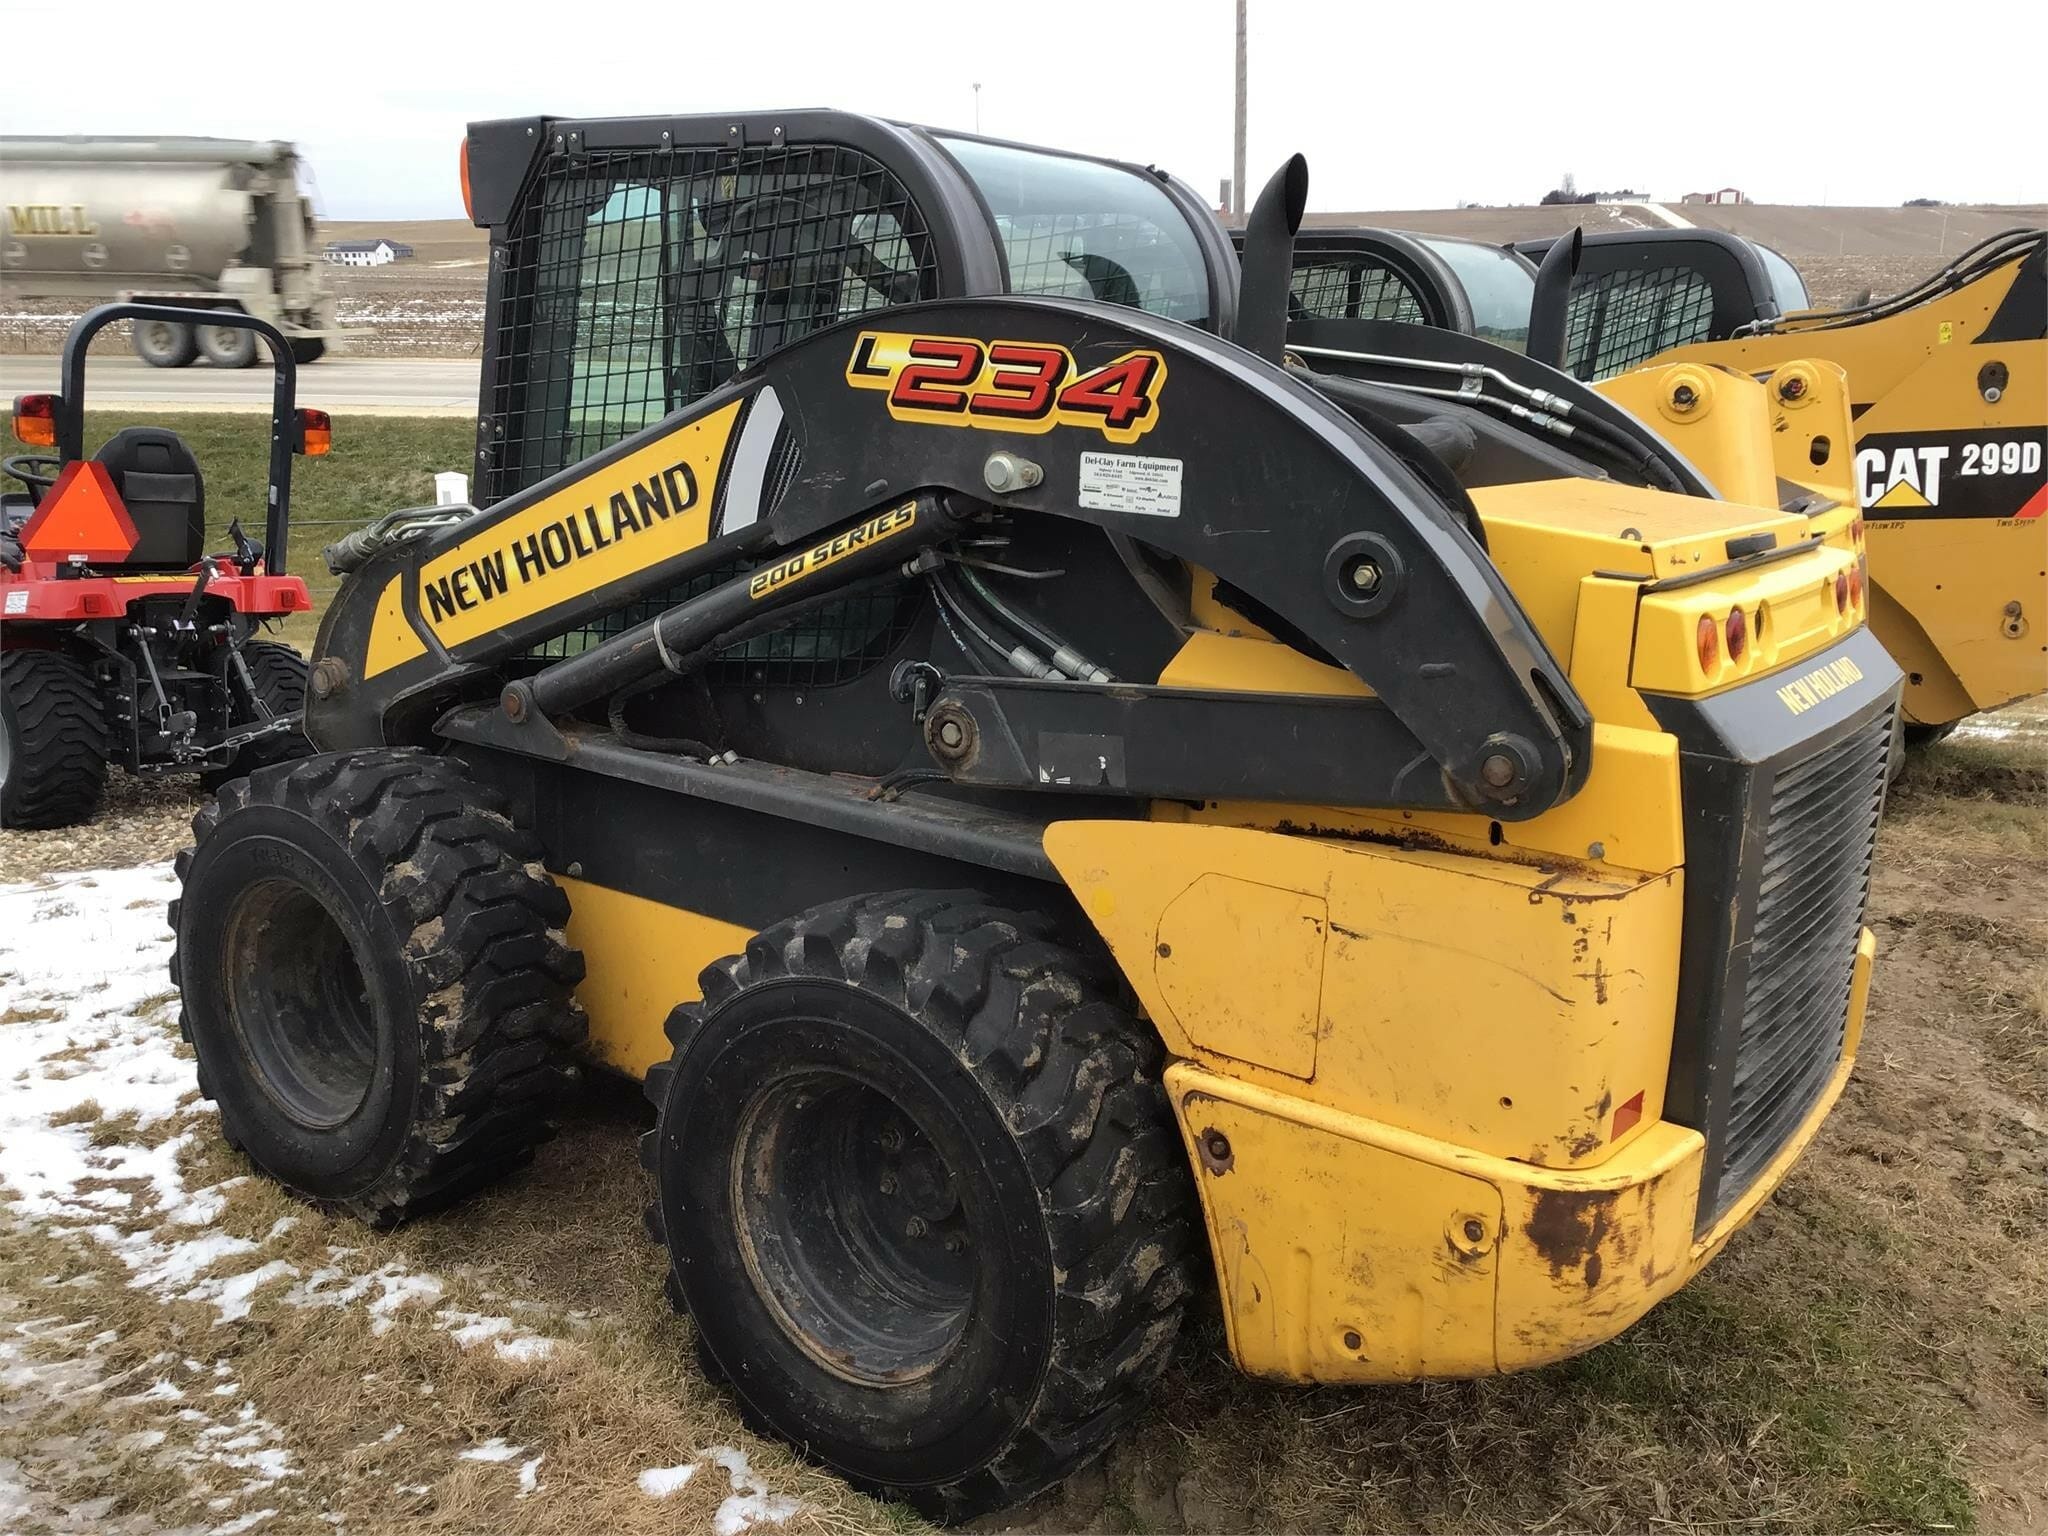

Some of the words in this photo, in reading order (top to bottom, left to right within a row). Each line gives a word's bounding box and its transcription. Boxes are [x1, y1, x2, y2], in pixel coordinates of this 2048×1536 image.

[6, 203, 99, 237] MILL
[848, 334, 1160, 432] L234
[1085, 456, 1114, 468] Del-Clay
[1117, 459, 1136, 468] Farm
[1138, 461, 1179, 473] Equipment
[1855, 445, 1950, 508] CAT
[1961, 441, 2042, 477] 299D
[424, 549, 509, 624] NEW
[512, 460, 699, 584] HOLLAND
[752, 554, 806, 595] 200
[812, 502, 914, 566] SERIES
[1776, 678, 1820, 715] NEW
[1804, 656, 1864, 700] HOLLAND
